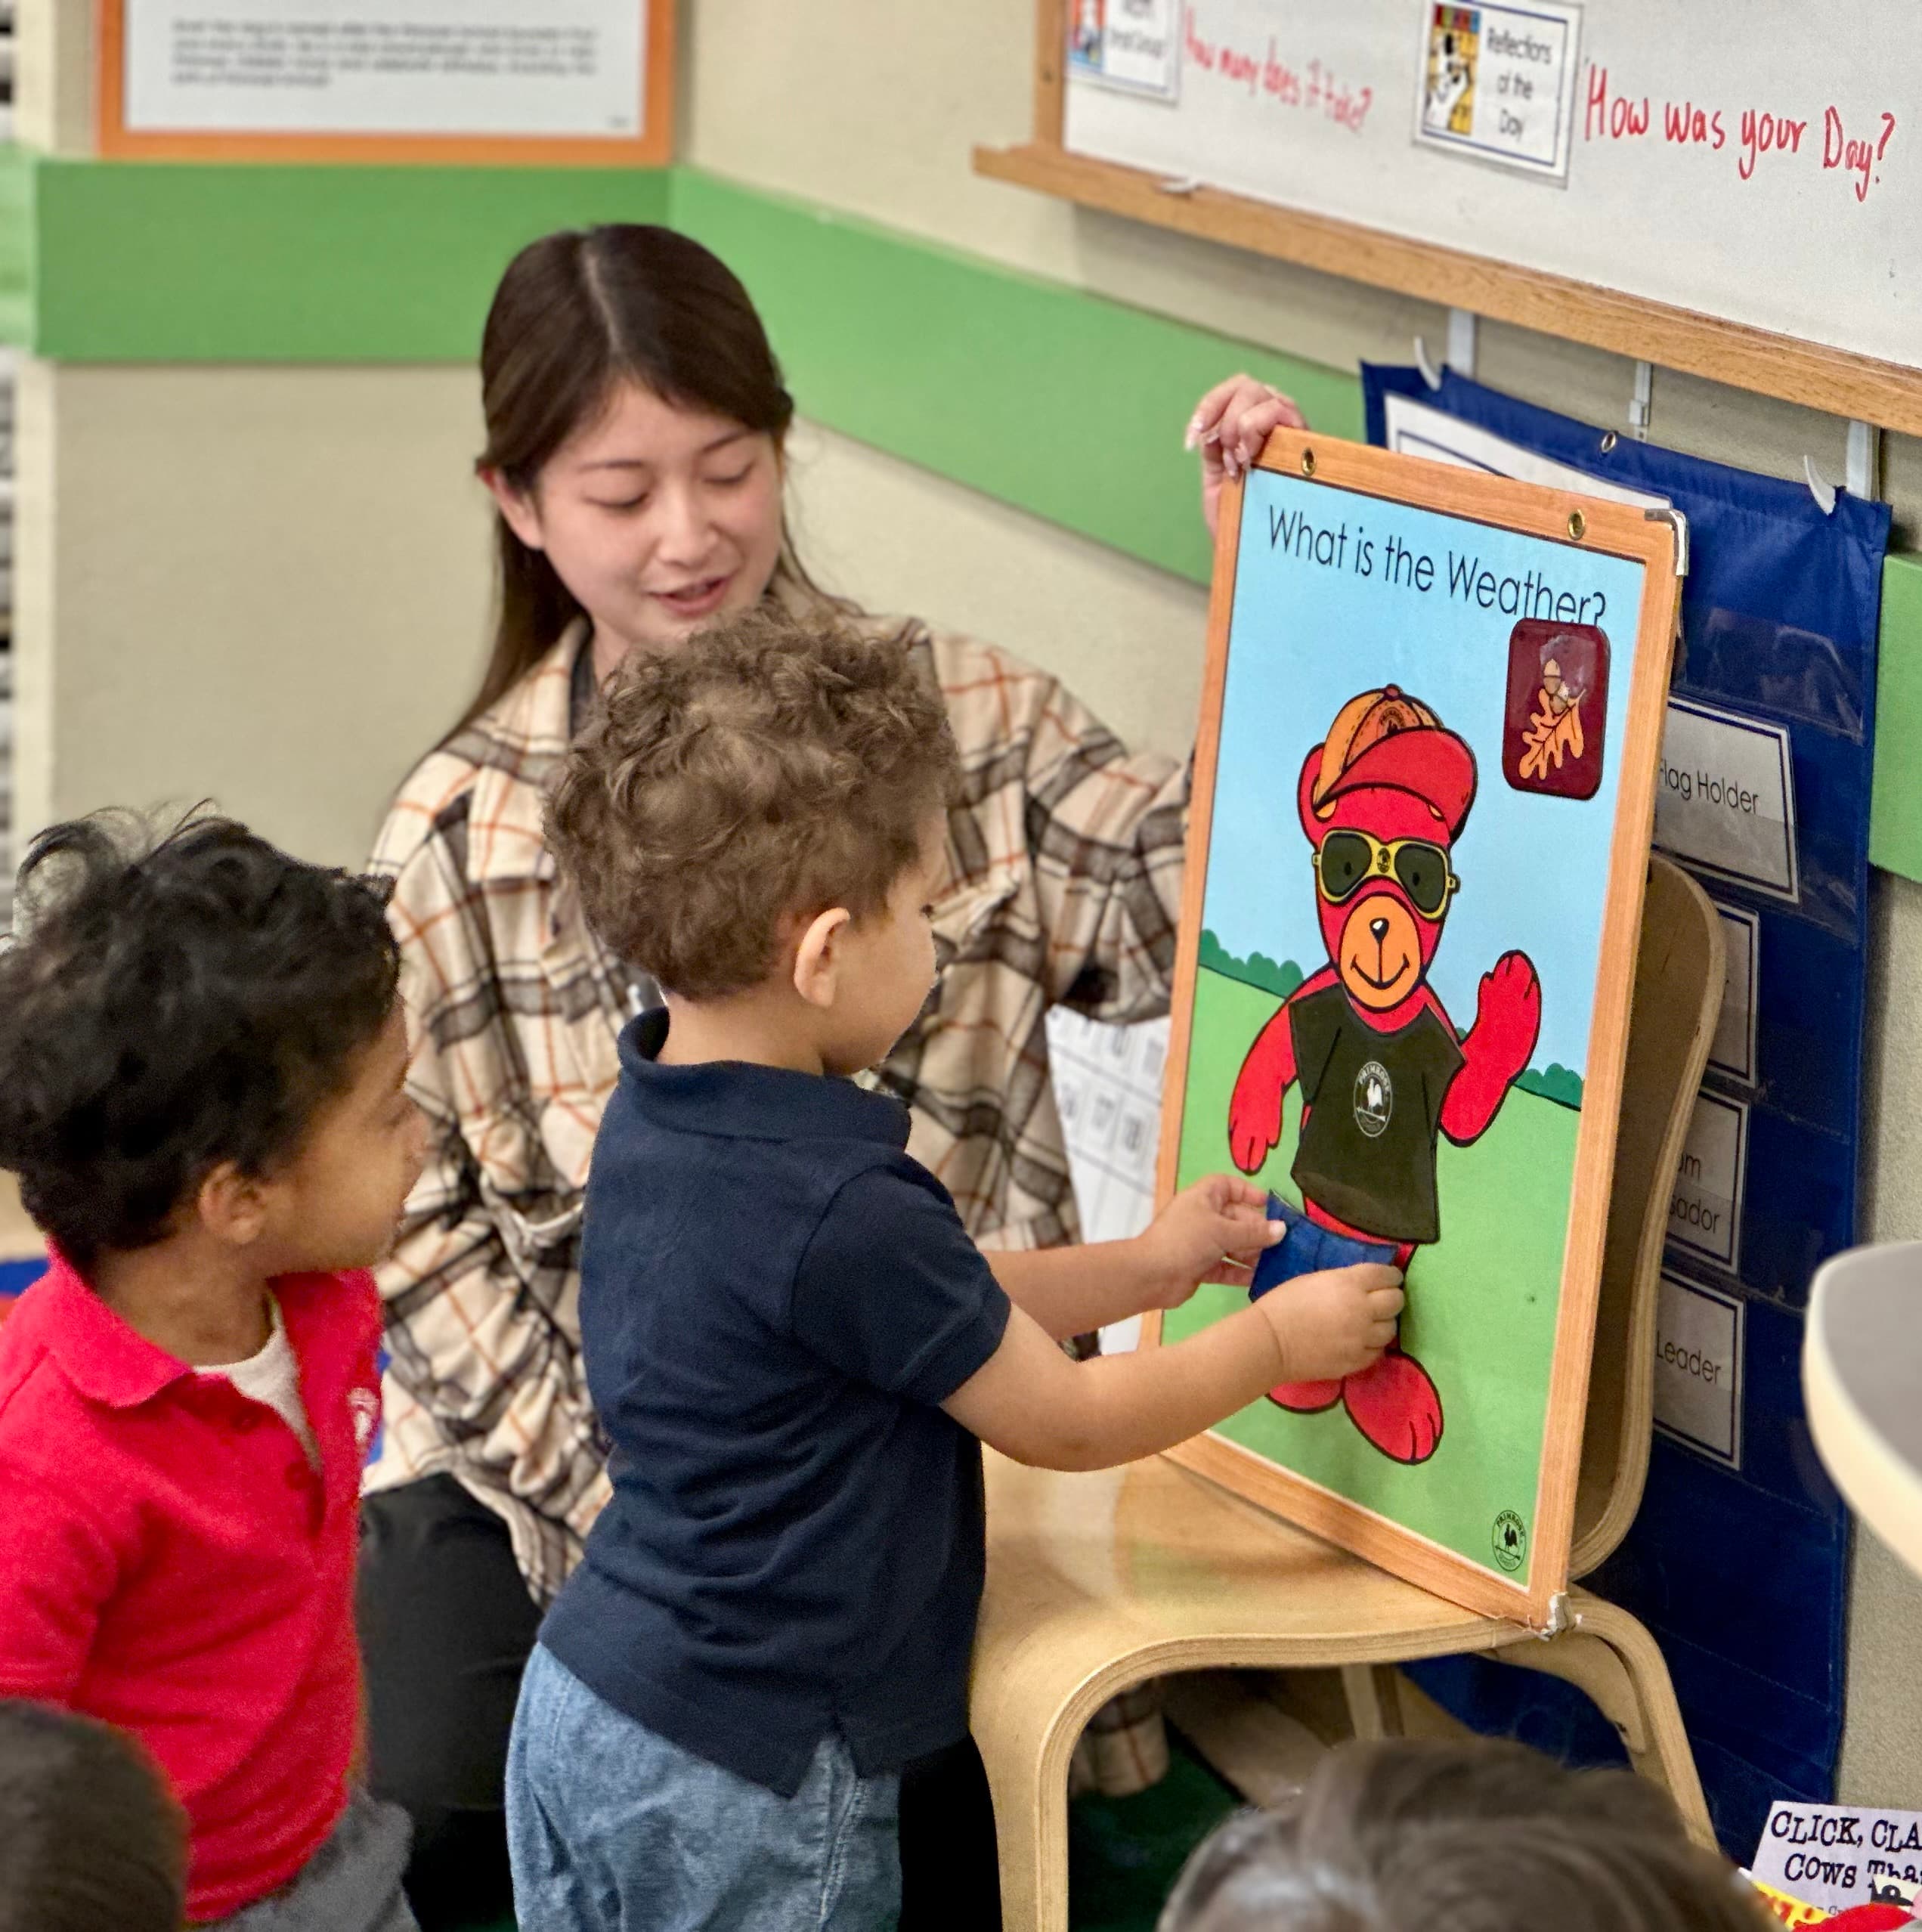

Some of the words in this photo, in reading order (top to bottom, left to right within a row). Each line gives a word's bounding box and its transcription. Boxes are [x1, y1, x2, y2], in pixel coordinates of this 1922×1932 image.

[1514, 73, 1533, 100] the
[1500, 108, 1523, 141] Day
[1585, 63, 1648, 141] How
[1665, 101, 1725, 150] was
[1738, 109, 1807, 180] your
[1823, 105, 1896, 203] Day?
[1270, 504, 1348, 569] What
[1354, 526, 1374, 577] is
[1385, 534, 1434, 592] the
[1448, 550, 1606, 625] Weather?
[1697, 769, 1758, 815] Holder
[1657, 1330, 1721, 1384] Leader
[1771, 1811, 1863, 1847] CLICK,
[1871, 1819, 1922, 1853] CLA
[1867, 1859, 1922, 1888] Tha
